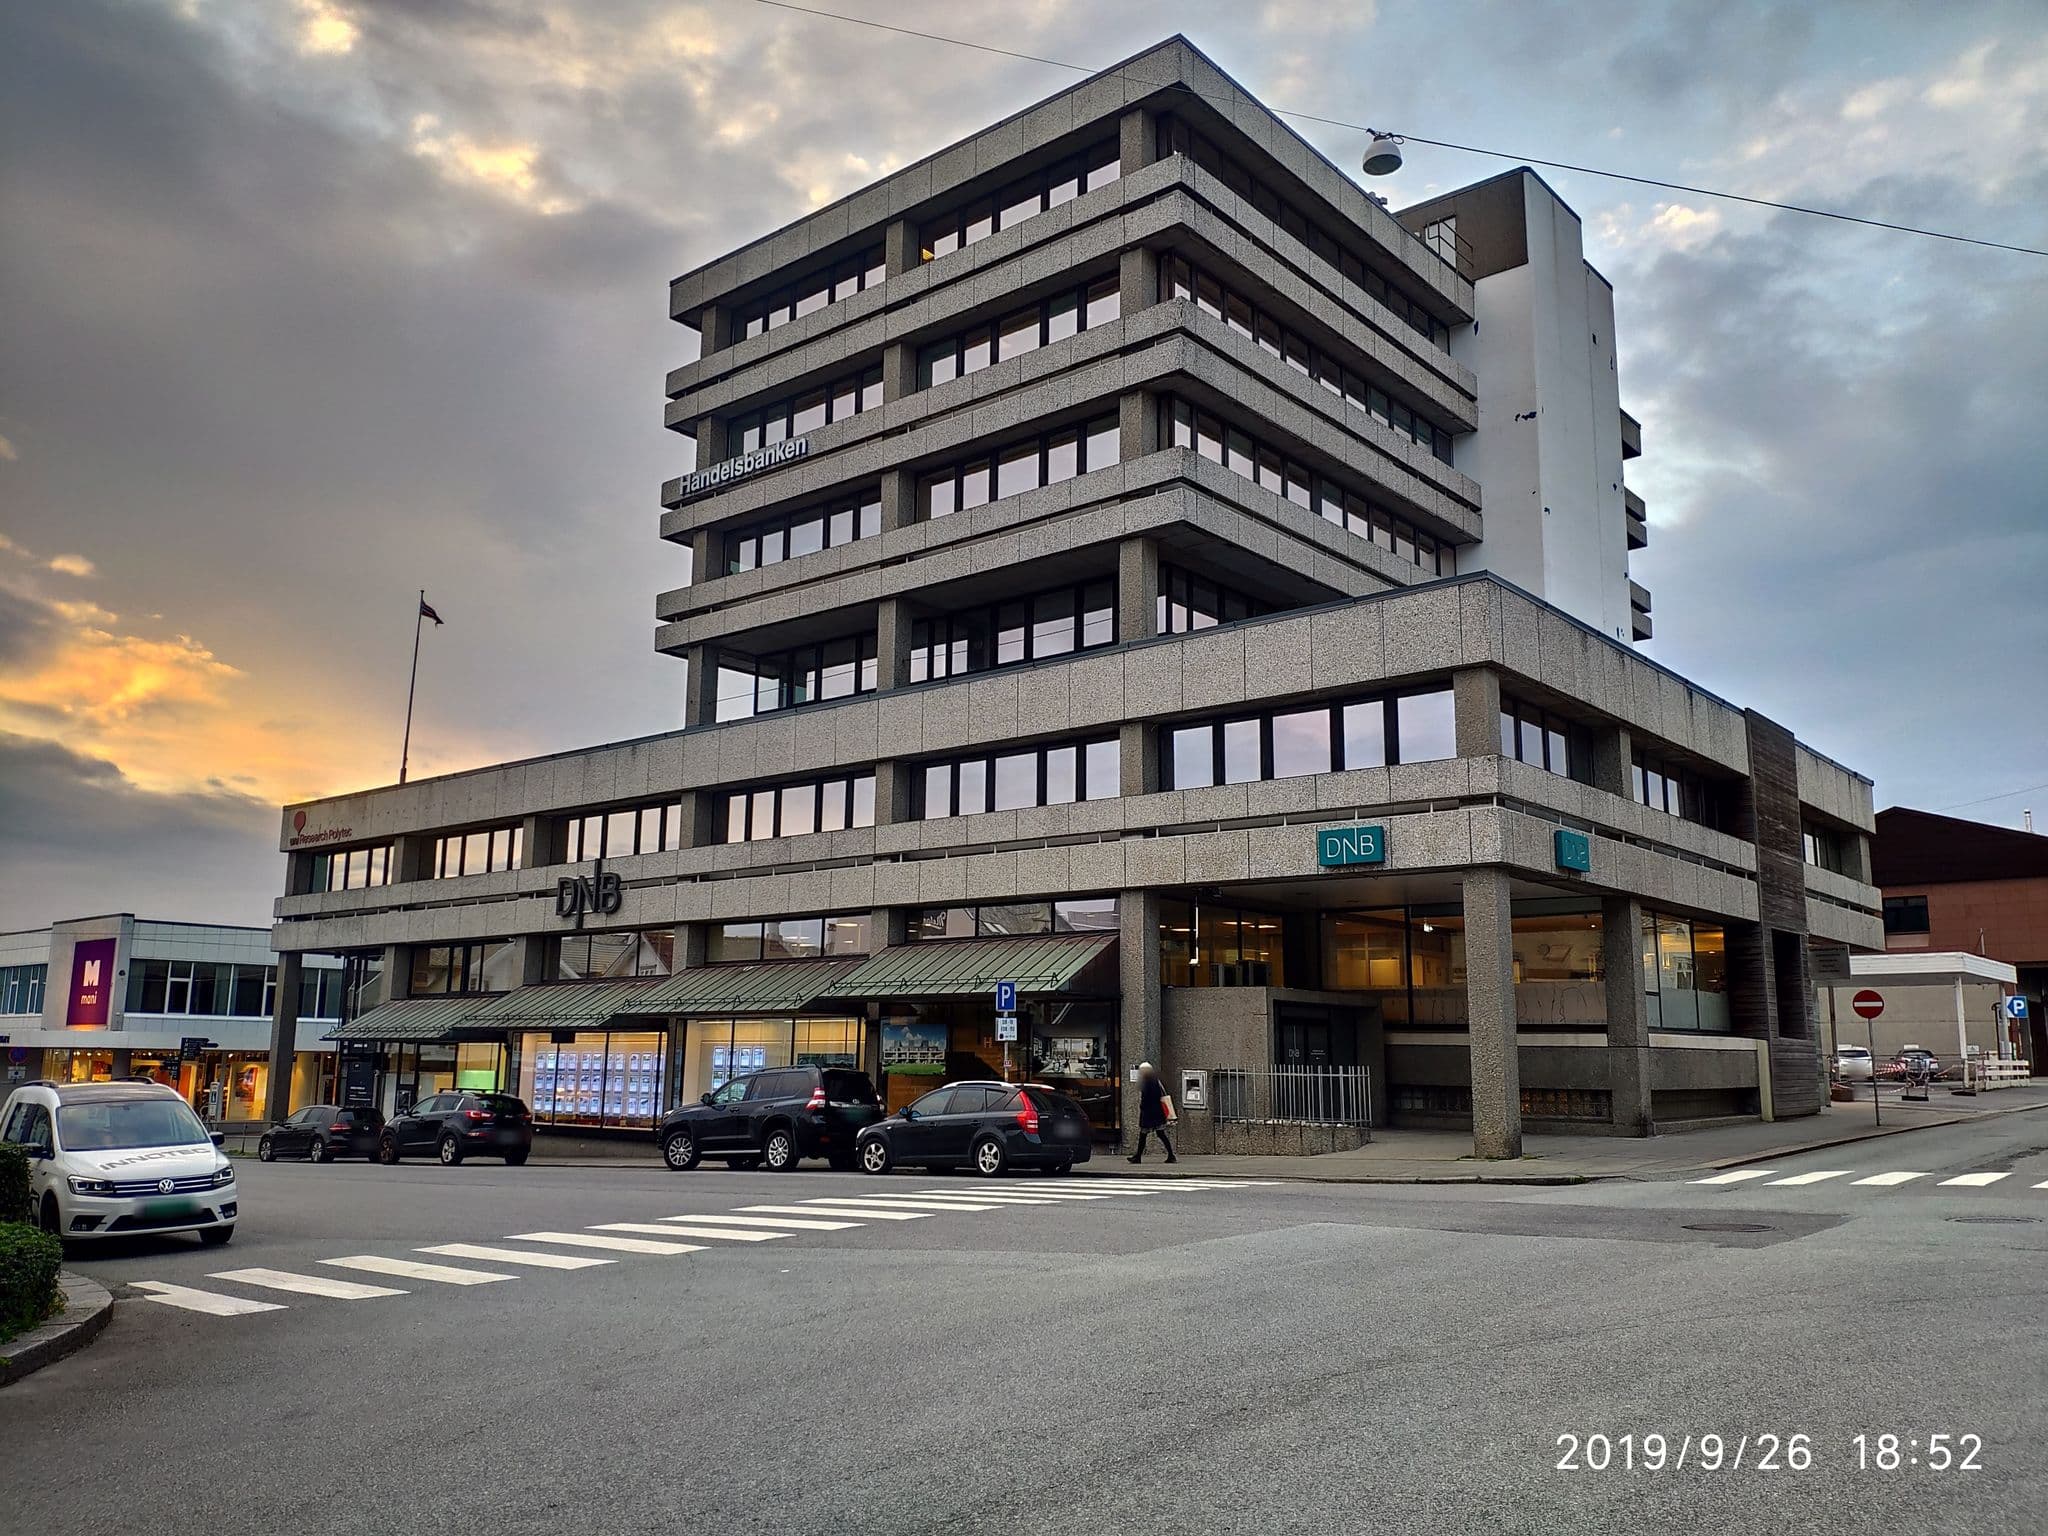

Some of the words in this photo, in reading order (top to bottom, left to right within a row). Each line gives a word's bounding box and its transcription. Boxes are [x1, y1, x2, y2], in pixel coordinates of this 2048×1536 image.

[680, 438, 808, 496] Handelsbanken
[300, 829, 328, 845] Research
[329, 826, 352, 841] Polytec
[1326, 827, 1374, 865] DNB
[556, 858, 622, 930] DNB
[83, 959, 101, 987] M
[1001, 985, 1011, 1008] P
[2013, 999, 2025, 1014] P
[98, 1148, 211, 1171] INNOTEC
